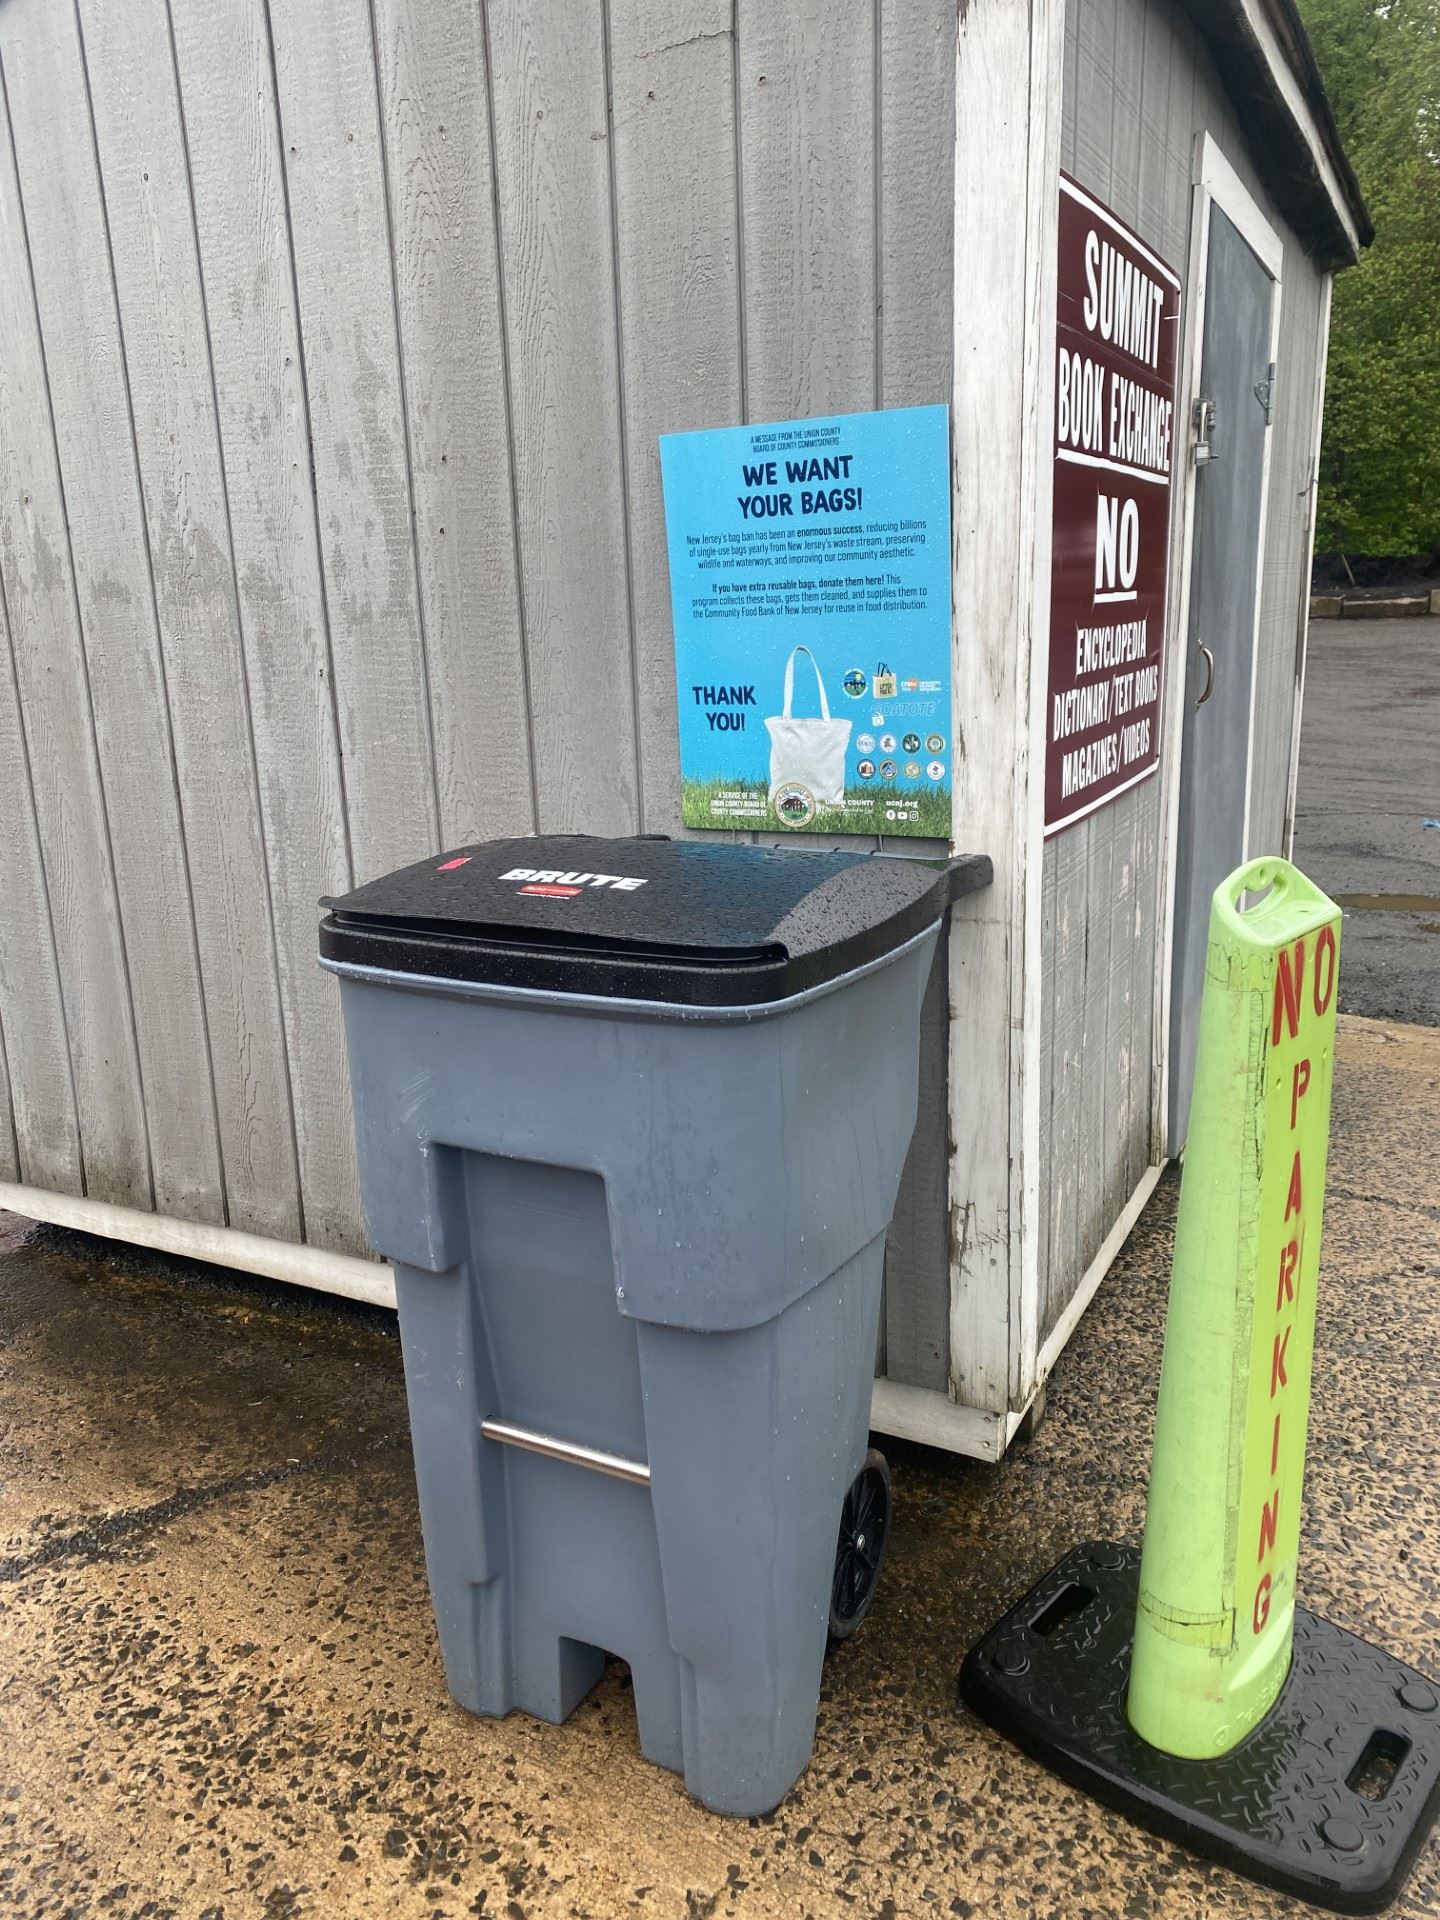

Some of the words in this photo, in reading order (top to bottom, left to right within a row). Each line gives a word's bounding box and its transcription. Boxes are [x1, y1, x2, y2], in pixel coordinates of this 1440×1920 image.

[1083, 229, 1164, 369] SUMMIT
[1058, 346, 1105, 452] BOOK
[1109, 372, 1172, 472] EXCHANGE
[753, 444, 770, 454] BOARD
[770, 443, 776, 452] OF
[778, 441, 797, 450] COUNTY
[798, 437, 840, 448] COMMISSIONERS
[754, 433, 778, 444] MESSAGE
[778, 432, 793, 441] FROM
[794, 430, 803, 439] THE
[804, 428, 820, 438] UNION
[820, 427, 840, 436] COUNTY
[742, 462, 778, 487] WE
[785, 455, 853, 483] WANT
[737, 493, 794, 519] YOUR
[801, 487, 862, 515] BAGS!
[686, 536, 700, 545] New
[701, 533, 727, 545] Jersey's
[729, 533, 740, 543] bag
[742, 531, 754, 541] ban
[756, 530, 768, 541] has
[769, 528, 786, 540] been
[787, 529, 795, 538] an
[796, 527, 832, 537] enormous
[833, 524, 865, 535] success,
[866, 521, 898, 533] reducing
[900, 520, 927, 530] billions
[689, 548, 696, 558] of
[697, 546, 730, 558] single-use
[731, 545, 747, 556] bags
[748, 543, 768, 555] yearly
[770, 542, 786, 552] from
[788, 542, 802, 551] New
[804, 538, 831, 550] Jersey's
[833, 538, 855, 548] waste
[856, 537, 884, 547] stream,
[886, 532, 926, 546] preserving
[1095, 494, 1139, 589] NO
[698, 559, 720, 569] wildlife
[722, 558, 735, 568] and
[736, 557, 774, 567] waterways,
[774, 555, 788, 565] and
[789, 553, 822, 565] improving
[824, 553, 836, 562] our
[837, 550, 878, 561] community
[879, 547, 915, 559] aesthetic.
[712, 584, 717, 592] If
[718, 585, 730, 595] you
[731, 583, 748, 592] have
[749, 582, 766, 592] extra
[768, 579, 798, 590] reusable
[799, 579, 817, 591] bags,
[819, 578, 843, 588] donate
[845, 577, 864, 587] them
[865, 575, 884, 585] here!
[886, 574, 901, 584] This
[692, 599, 718, 608] program
[720, 596, 745, 606] collects
[746, 595, 764, 604] these
[766, 594, 784, 604] bags,
[785, 593, 800, 604] gets
[801, 592, 819, 601] them
[821, 590, 850, 601] cleaned,
[851, 589, 865, 600] and
[867, 588, 896, 600] supplies
[898, 587, 918, 597] them
[919, 587, 927, 596] to
[693, 610, 704, 619] the
[705, 608, 740, 619] Community
[742, 607, 757, 617] Food
[759, 606, 776, 616] Bank
[776, 606, 784, 615] of
[785, 605, 799, 615] New
[801, 604, 822, 616] Jersey
[824, 604, 835, 613] for
[836, 604, 856, 613] reuse
[857, 602, 864, 612] in
[865, 601, 881, 612] food
[883, 600, 927, 611] distribution.
[1076, 619, 1147, 676] ENCYCLOPEDIA
[692, 686, 757, 705] THANK
[1053, 673, 1134, 742] DICTIONARY/TEXT
[1135, 664, 1158, 709] BOOKS
[705, 712, 745, 732] YOU!
[1062, 717, 1150, 800] MAGAZINES/VIDEOS
[886, 800, 918, 808] ucnj.org
[498, 868, 649, 891] BRUTE
[1272, 925, 1336, 1047] NO
[1253, 1058, 1311, 1635] PARKING
